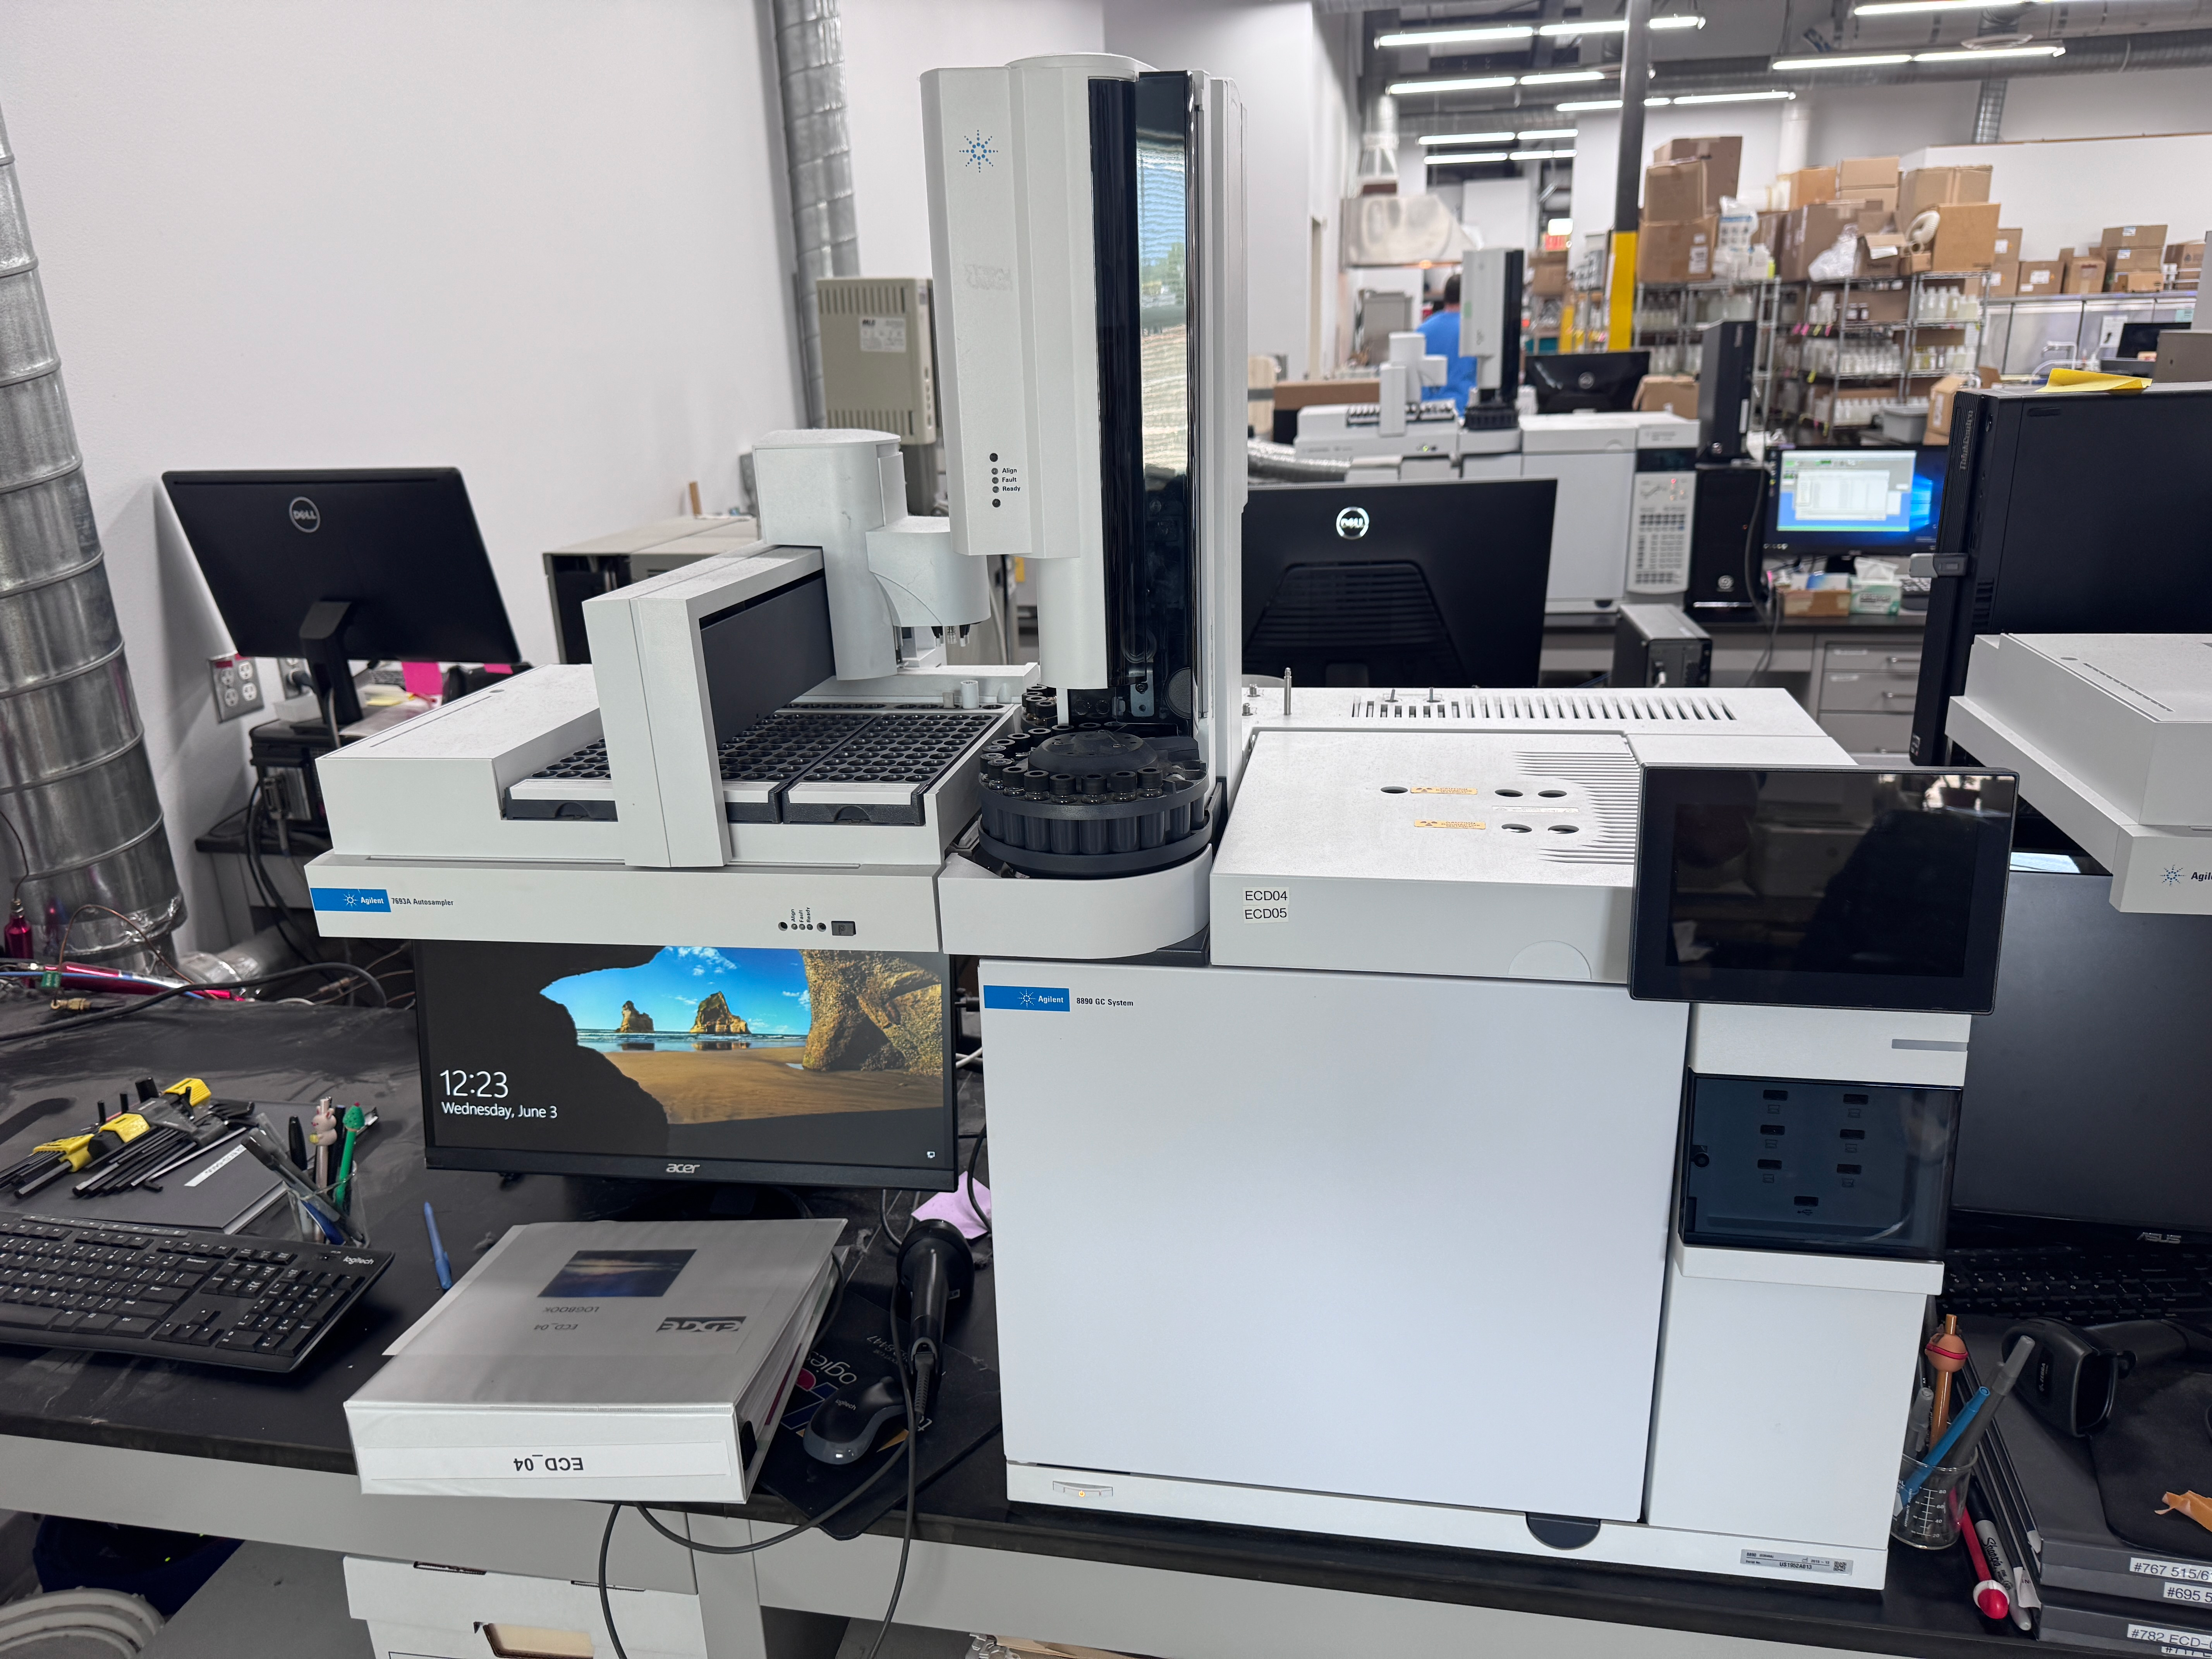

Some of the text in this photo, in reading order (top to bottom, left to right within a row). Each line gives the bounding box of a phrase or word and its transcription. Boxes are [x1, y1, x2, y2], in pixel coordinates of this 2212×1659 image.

[293, 510, 317, 520] DELL
[361, 896, 384, 905] Agilent
[1245, 890, 1288, 901] ECD04
[391, 897, 453, 907] 7693A Autosampler
[1245, 908, 1287, 920] ECD05
[1038, 995, 1064, 1004] Agilent
[1108, 999, 1133, 1008] System
[440, 1070, 508, 1098] 12:23
[441, 1102, 558, 1120] Wednesday, June 3
[666, 1163, 700, 1174] acer
[2137, 1232, 2182, 1244] ASUS
[343, 1256, 374, 1265] logitech
[835, 1399, 856, 1410] logitech
[514, 1455, 584, 1471] ECD_04
[1982, 1537, 2002, 1567] Sharpie
[2133, 1562, 2212, 1581] #767 515/6
[2167, 1587, 2200, 1601] #695
[2131, 1629, 2212, 1650] #782 ECD-
